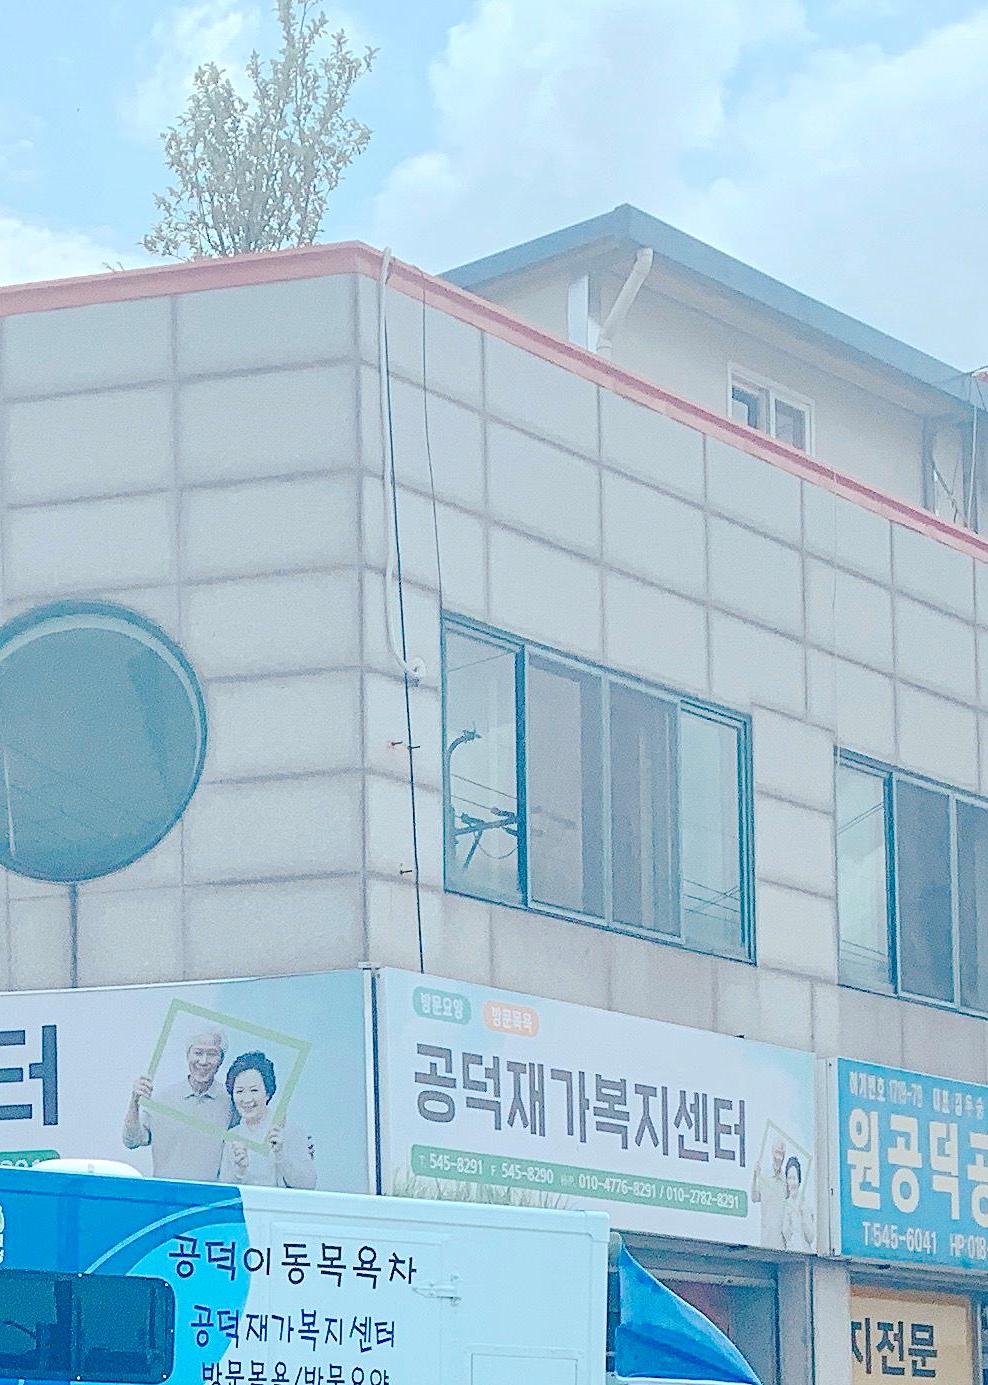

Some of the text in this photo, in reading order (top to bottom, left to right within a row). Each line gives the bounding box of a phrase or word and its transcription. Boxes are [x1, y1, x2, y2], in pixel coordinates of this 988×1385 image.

[414, 1042, 747, 1168] 공덕재가복지센터
[429, 1154, 483, 1176] 545-8291
[501, 1162, 554, 1185] 545-8290
[579, 1172, 657, 1198] 010-4776-8291
[168, 1234, 417, 1290] 공덕이동목욕차
[191, 1304, 396, 1353] 공덕재가복지센터
